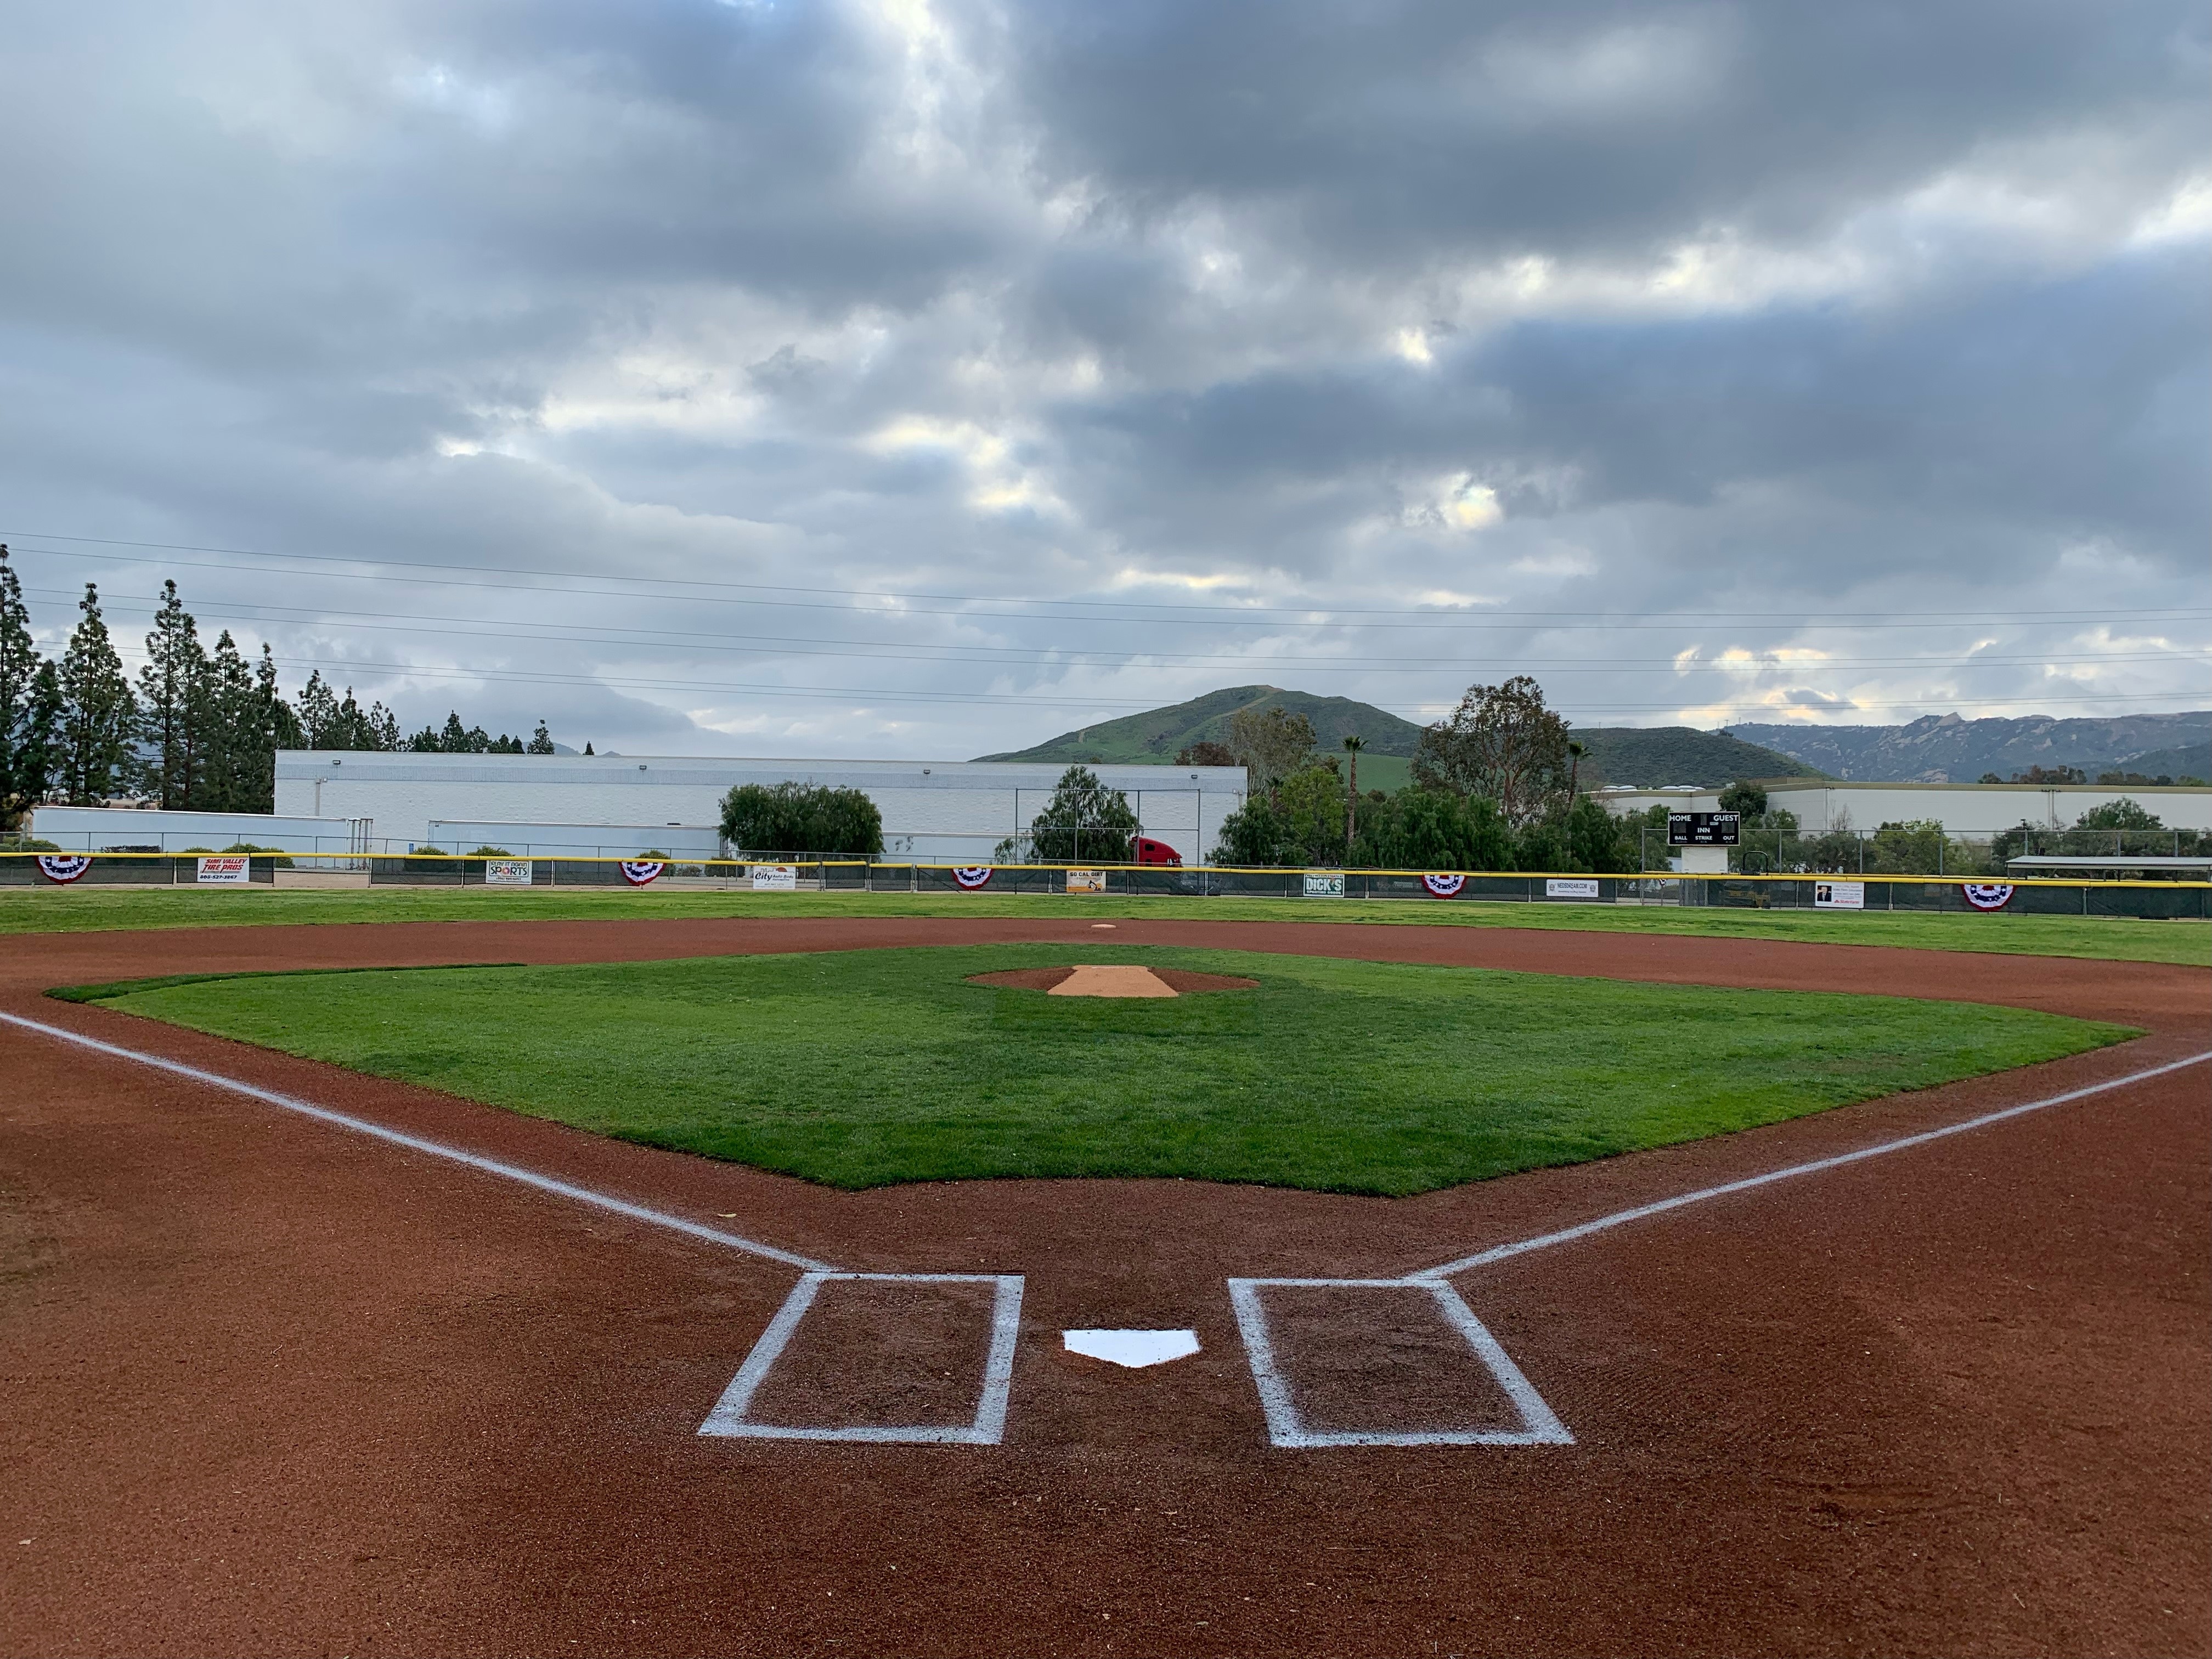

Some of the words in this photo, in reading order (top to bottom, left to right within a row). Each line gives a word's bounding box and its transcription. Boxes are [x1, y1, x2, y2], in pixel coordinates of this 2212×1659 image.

[202, 865, 221, 873] TIRE
[219, 865, 243, 873] PROS
[490, 866, 527, 876] SPORTS
[755, 872, 773, 882] City
[1306, 878, 1342, 891] DICK'S
